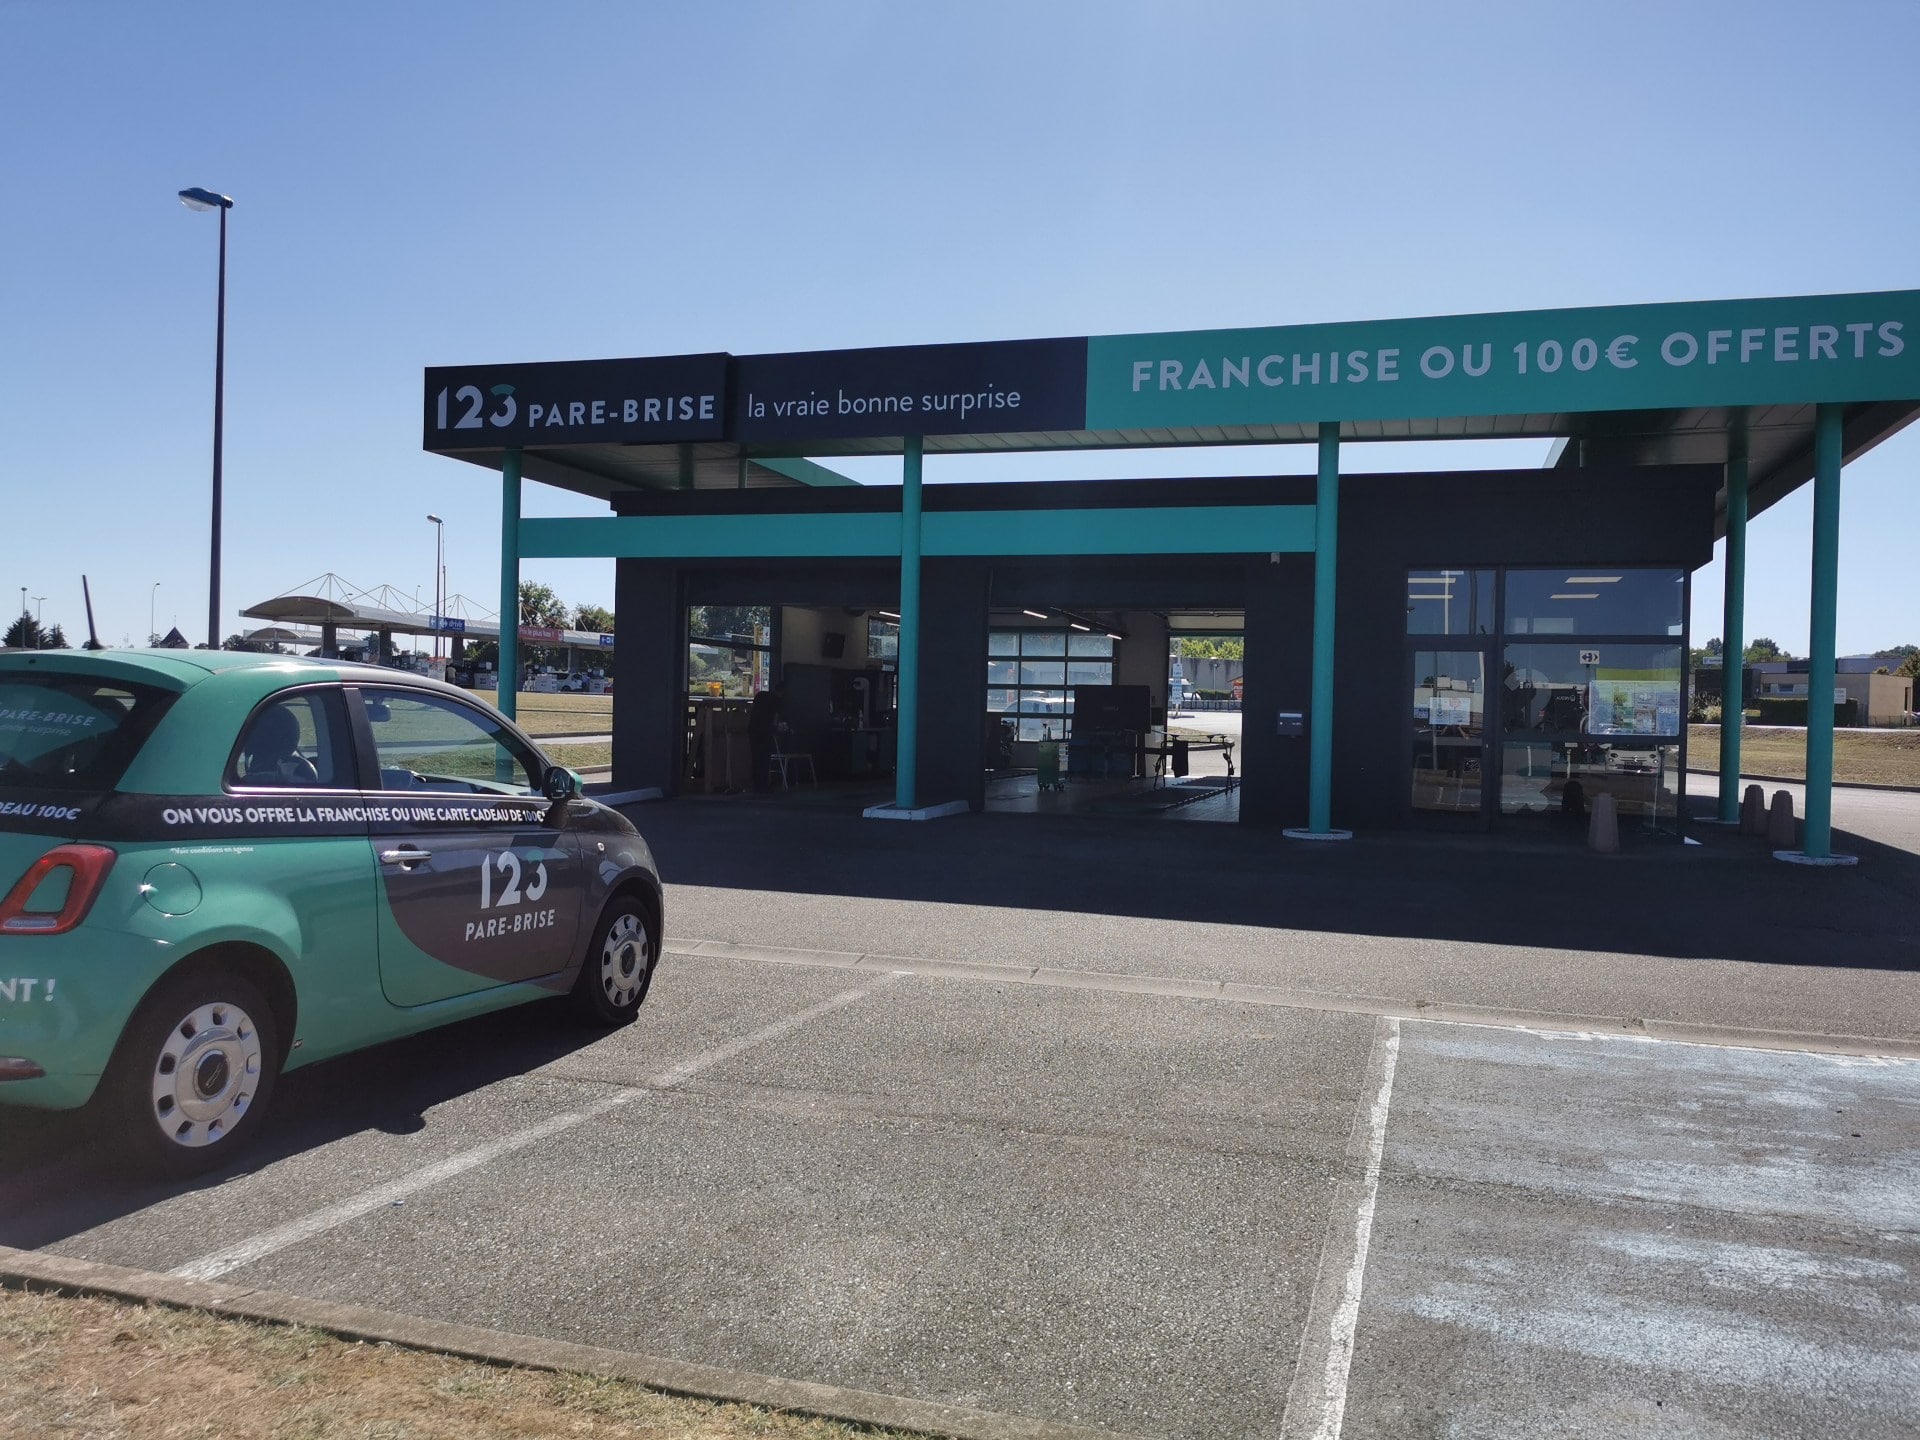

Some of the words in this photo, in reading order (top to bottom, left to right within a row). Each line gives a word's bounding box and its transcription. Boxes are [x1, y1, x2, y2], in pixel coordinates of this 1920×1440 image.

[1132, 348, 1400, 392] FRANCHISE
[1419, 343, 1492, 379] OU
[1512, 335, 1639, 375] 100€
[1660, 321, 1905, 367] OFFERTS
[437, 384, 517, 430] 123
[528, 395, 715, 428] PARE-BRISE
[748, 393, 765, 418] la
[773, 391, 830, 417] vraie
[837, 389, 913, 415] bonne
[921, 383, 1021, 420] surprise
[0, 709, 96, 726] PARE-BRISE
[37, 805, 82, 820] 100€
[163, 808, 194, 825] ON
[195, 808, 244, 824] VOUS
[245, 807, 296, 823] OFFRE
[296, 807, 317, 822] LA
[317, 807, 390, 822] FRANCHISE
[391, 807, 410, 822] OU
[412, 807, 436, 822] UNE
[436, 808, 471, 822] CARTE
[470, 808, 509, 822] CADEAU
[509, 809, 523, 822] DE
[481, 849, 547, 910] 123
[465, 909, 555, 941] PARE-BRISE
